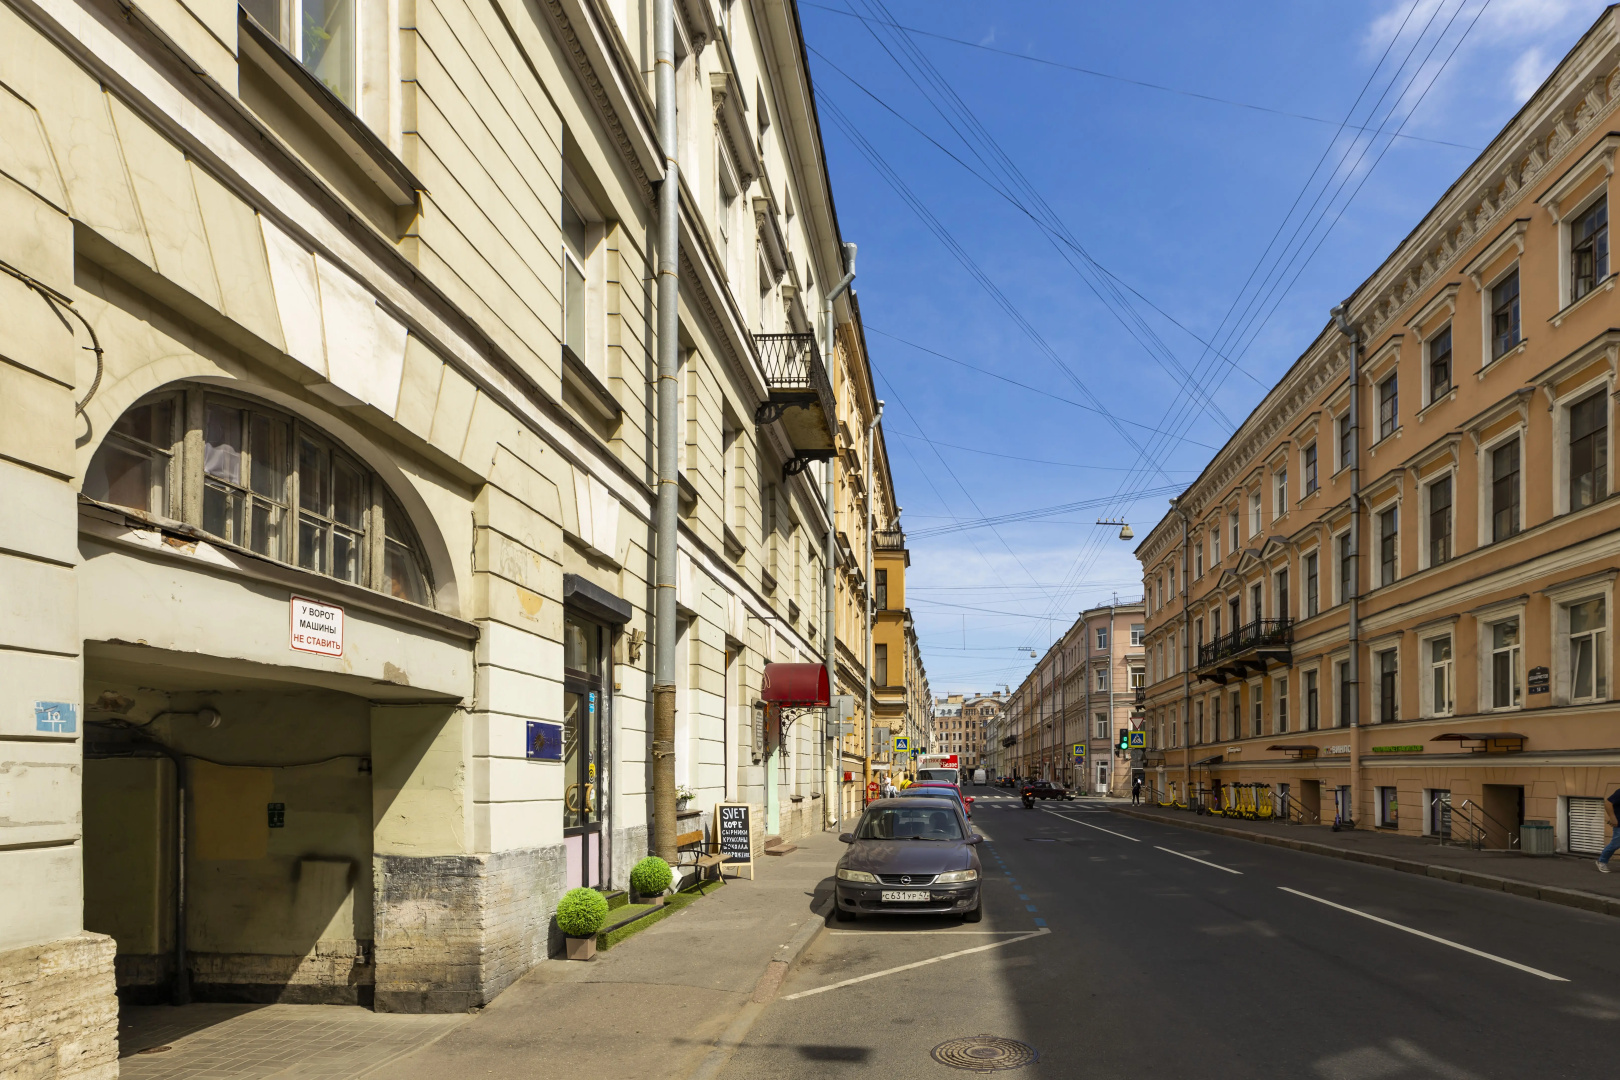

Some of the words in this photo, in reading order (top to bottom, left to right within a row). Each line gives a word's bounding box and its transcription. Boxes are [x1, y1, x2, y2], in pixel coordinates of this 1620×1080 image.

[302, 606, 307, 614] У
[309, 608, 335, 620] ВОРОТ
[300, 619, 336, 634] МАШИНЫ
[293, 634, 304, 643] НЕ
[306, 636, 341, 650] СТАВИТЬ
[722, 807, 747, 820] SVET
[723, 820, 743, 829] КОФЕ
